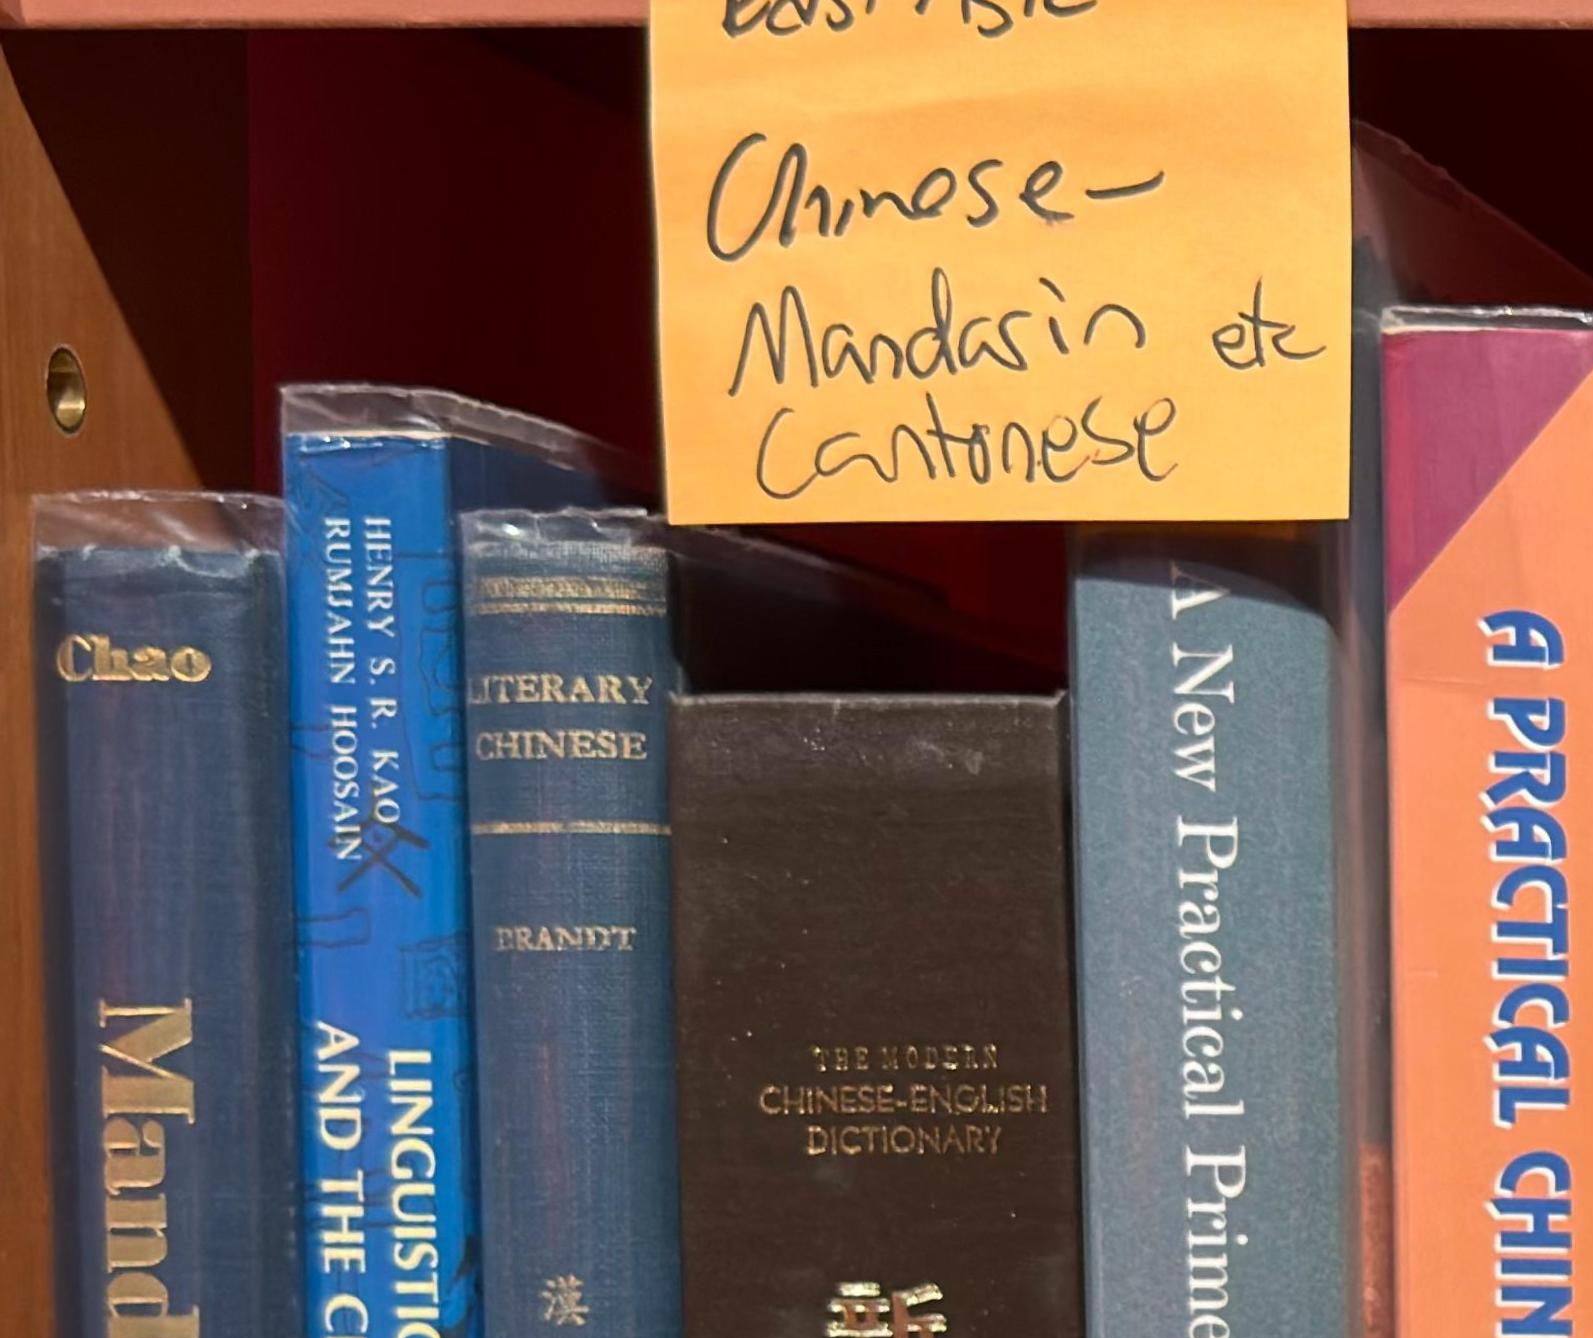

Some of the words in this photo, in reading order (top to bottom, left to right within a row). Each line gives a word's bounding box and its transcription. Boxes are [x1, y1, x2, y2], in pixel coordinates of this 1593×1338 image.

[728, 267, 1145, 397] Mandarin
[1212, 278, 1327, 370] etc
[756, 392, 1178, 500] Cantonese
[323, 516, 357, 686] RUMJAHN
[363, 516, 396, 635] HENRY
[1170, 560, 1230, 620] A
[56, 633, 212, 684] Chao
[369, 657, 395, 687] S.
[1478, 609, 1566, 671] A
[370, 697, 396, 729] R.
[468, 673, 653, 704] LITERARY
[1171, 642, 1235, 793] New
[475, 729, 648, 760] CHINESE
[330, 705, 363, 862] HOOSAIN
[370, 749, 402, 825] KAO
[495, 925, 637, 952] BRANDT
[1479, 696, 1573, 1130] PRACTICAL
[1175, 815, 1244, 1119] Practical
[315, 1020, 364, 1151] AND
[811, 1044, 869, 1072] THE
[881, 1043, 999, 1071] MODERN
[759, 1084, 1049, 1115] CHINESE-ENGLISH
[806, 1124, 1002, 1156] DICTIONARY
[318, 1169, 366, 1274] THE
